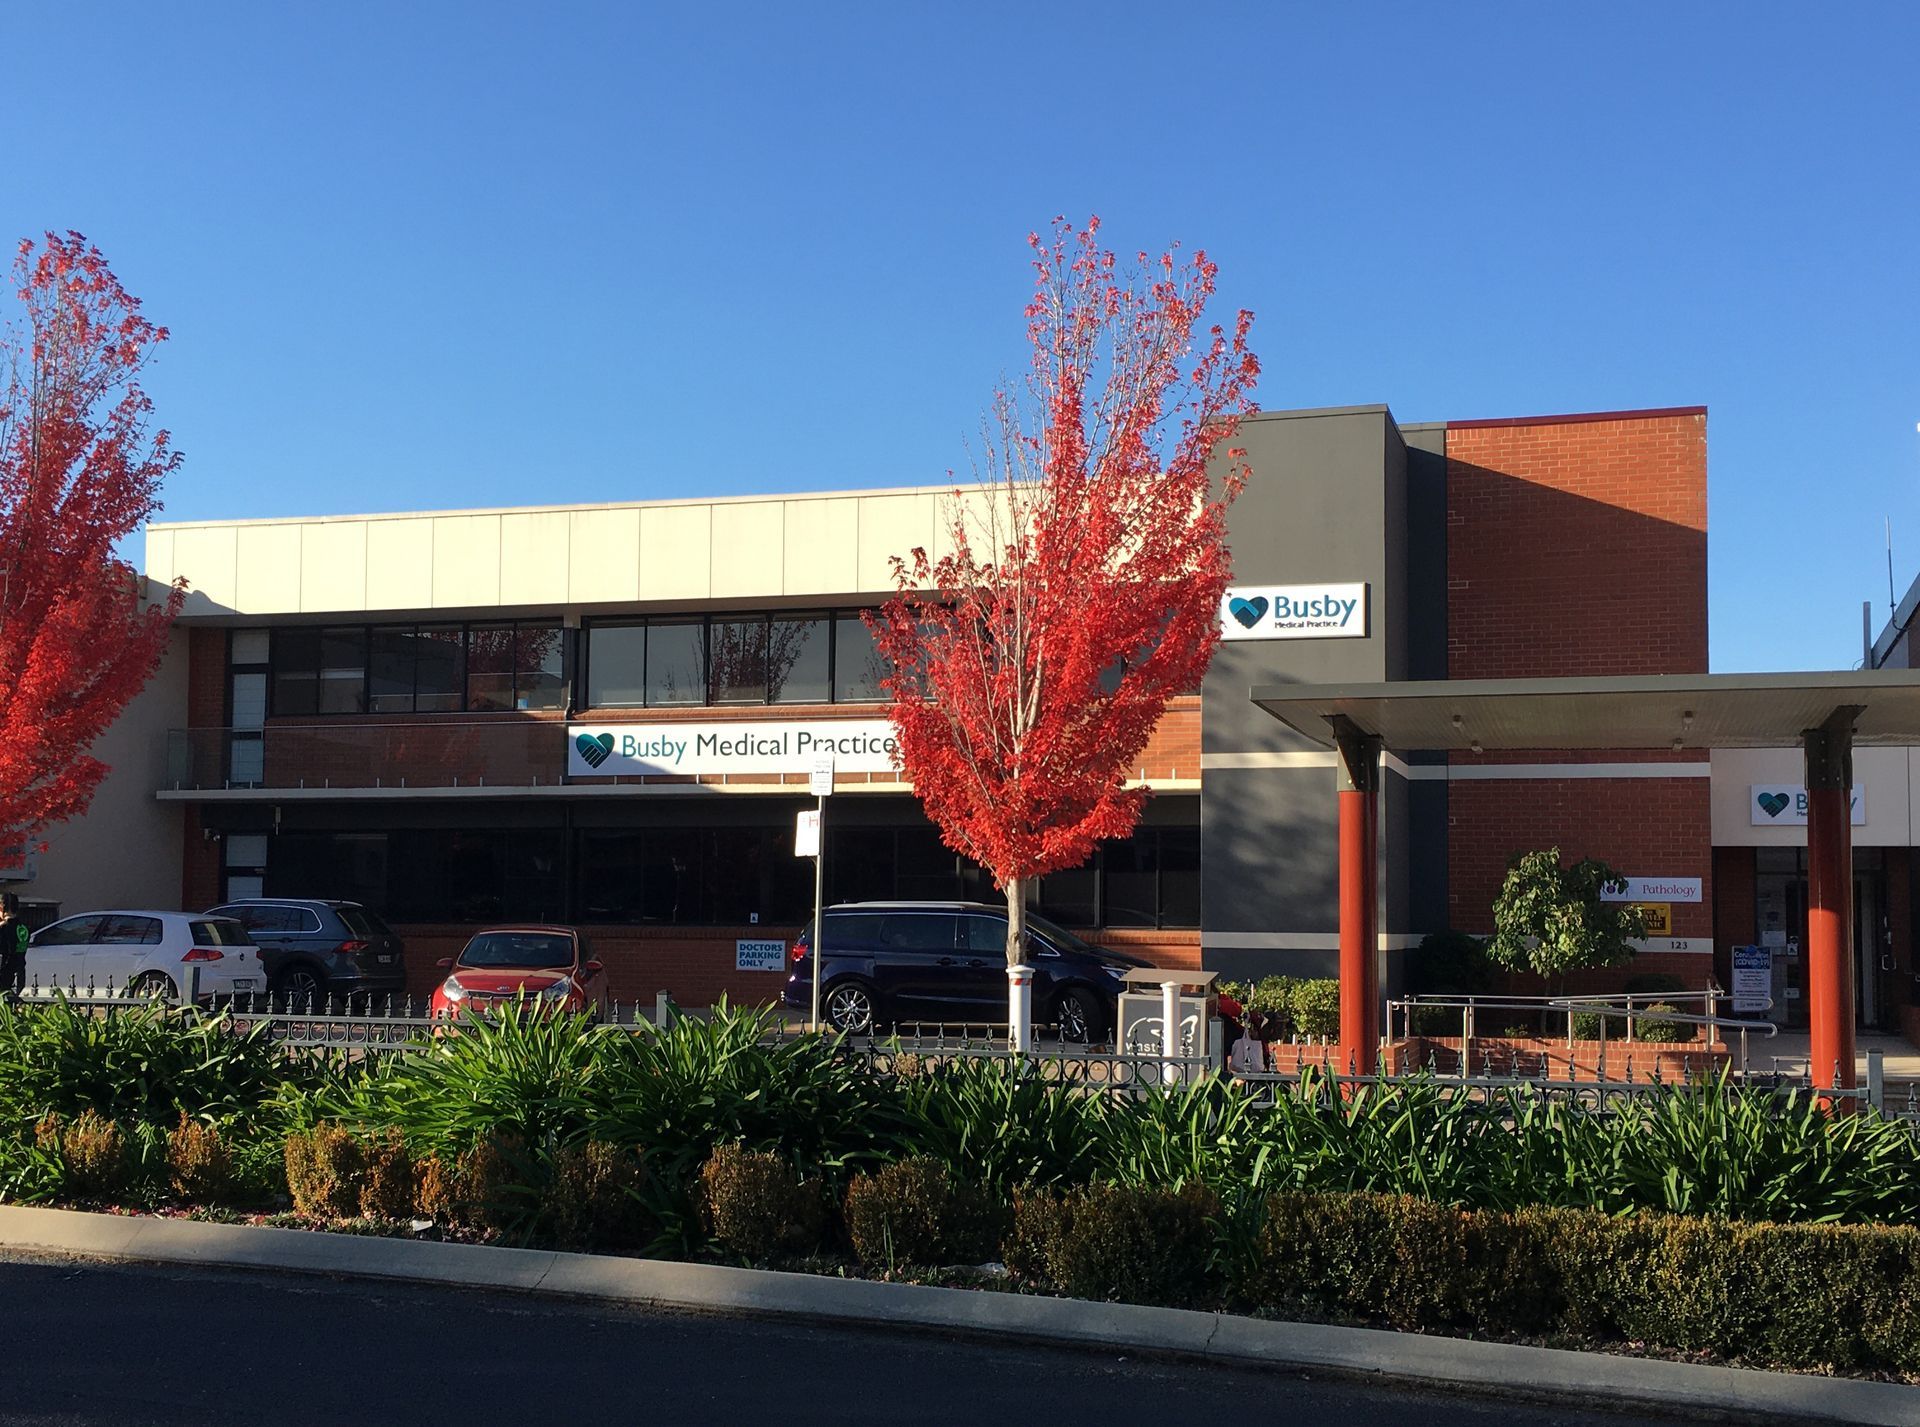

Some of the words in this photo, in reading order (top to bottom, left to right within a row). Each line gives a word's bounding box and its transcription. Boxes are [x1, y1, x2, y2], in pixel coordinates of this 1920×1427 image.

[1274, 594, 1357, 628] Busby
[1274, 620, 1304, 628] Medical
[1306, 620, 1337, 628] Practice
[622, 735, 687, 765] Busby
[696, 732, 788, 757] Medical
[796, 731, 897, 755] Practice
[1642, 884, 1696, 898] Pathology
[739, 943, 783, 951] DOCTORS
[1671, 941, 1688, 950] 123
[739, 951, 781, 959] PARKING
